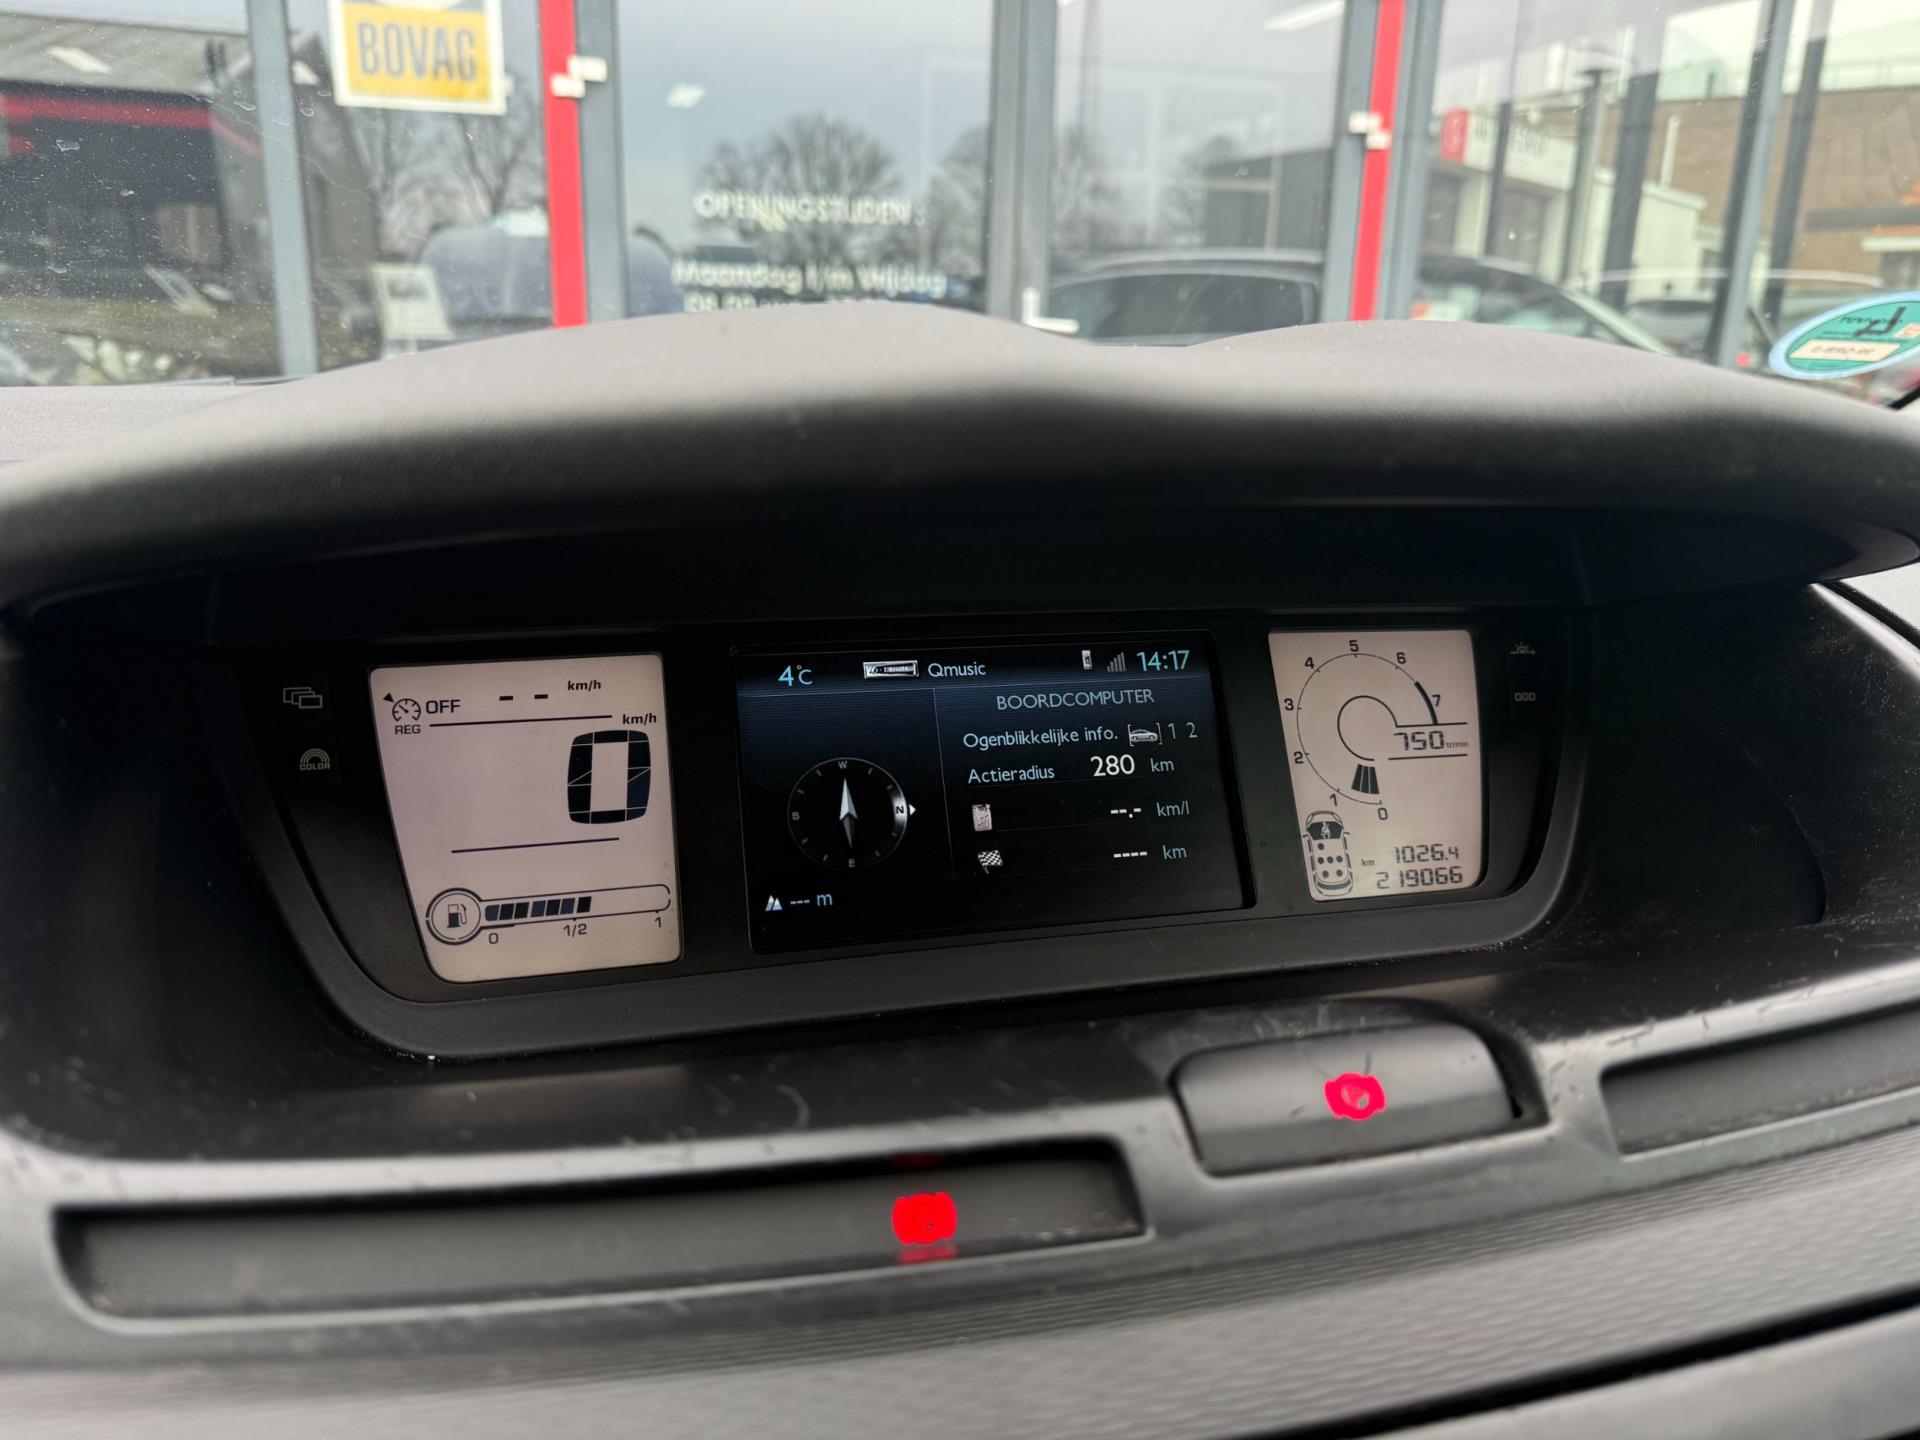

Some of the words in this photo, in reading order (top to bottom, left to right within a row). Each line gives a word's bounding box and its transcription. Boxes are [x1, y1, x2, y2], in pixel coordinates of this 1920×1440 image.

[357, 21, 478, 82] BOVAG
[1349, 640, 1359, 652] 5
[1137, 650, 1190, 671] 14:17
[1304, 657, 1314, 669] 4
[1396, 652, 1406, 664] 6
[927, 661, 987, 678] Qmusic
[567, 680, 601, 692] km/h
[996, 689, 1155, 710] BOORDCOMPUTER
[1284, 699, 1294, 711] 3
[1431, 694, 1442, 706] 7
[425, 699, 461, 715] OFF
[622, 713, 657, 726] km/h
[394, 724, 421, 735] REG
[963, 729, 1080, 751] Ogenblikkelijke
[1085, 726, 1118, 742] info.
[1186, 722, 1198, 738] 2
[1393, 730, 1445, 751] 750
[1294, 752, 1304, 765] 2
[968, 765, 1055, 784] Actieradius
[1090, 754, 1135, 777] 280
[1151, 758, 1175, 773] km
[567, 730, 651, 824] 0
[1329, 793, 1338, 806] 1
[1156, 800, 1190, 817] km/l
[1377, 808, 1388, 820] 0
[1162, 845, 1187, 861] km
[1394, 843, 1460, 864] 1026.4
[1361, 858, 1375, 867] km
[816, 893, 833, 906] m
[654, 916, 662, 928] 1
[563, 923, 588, 937] 1/2
[488, 932, 499, 945] 0
